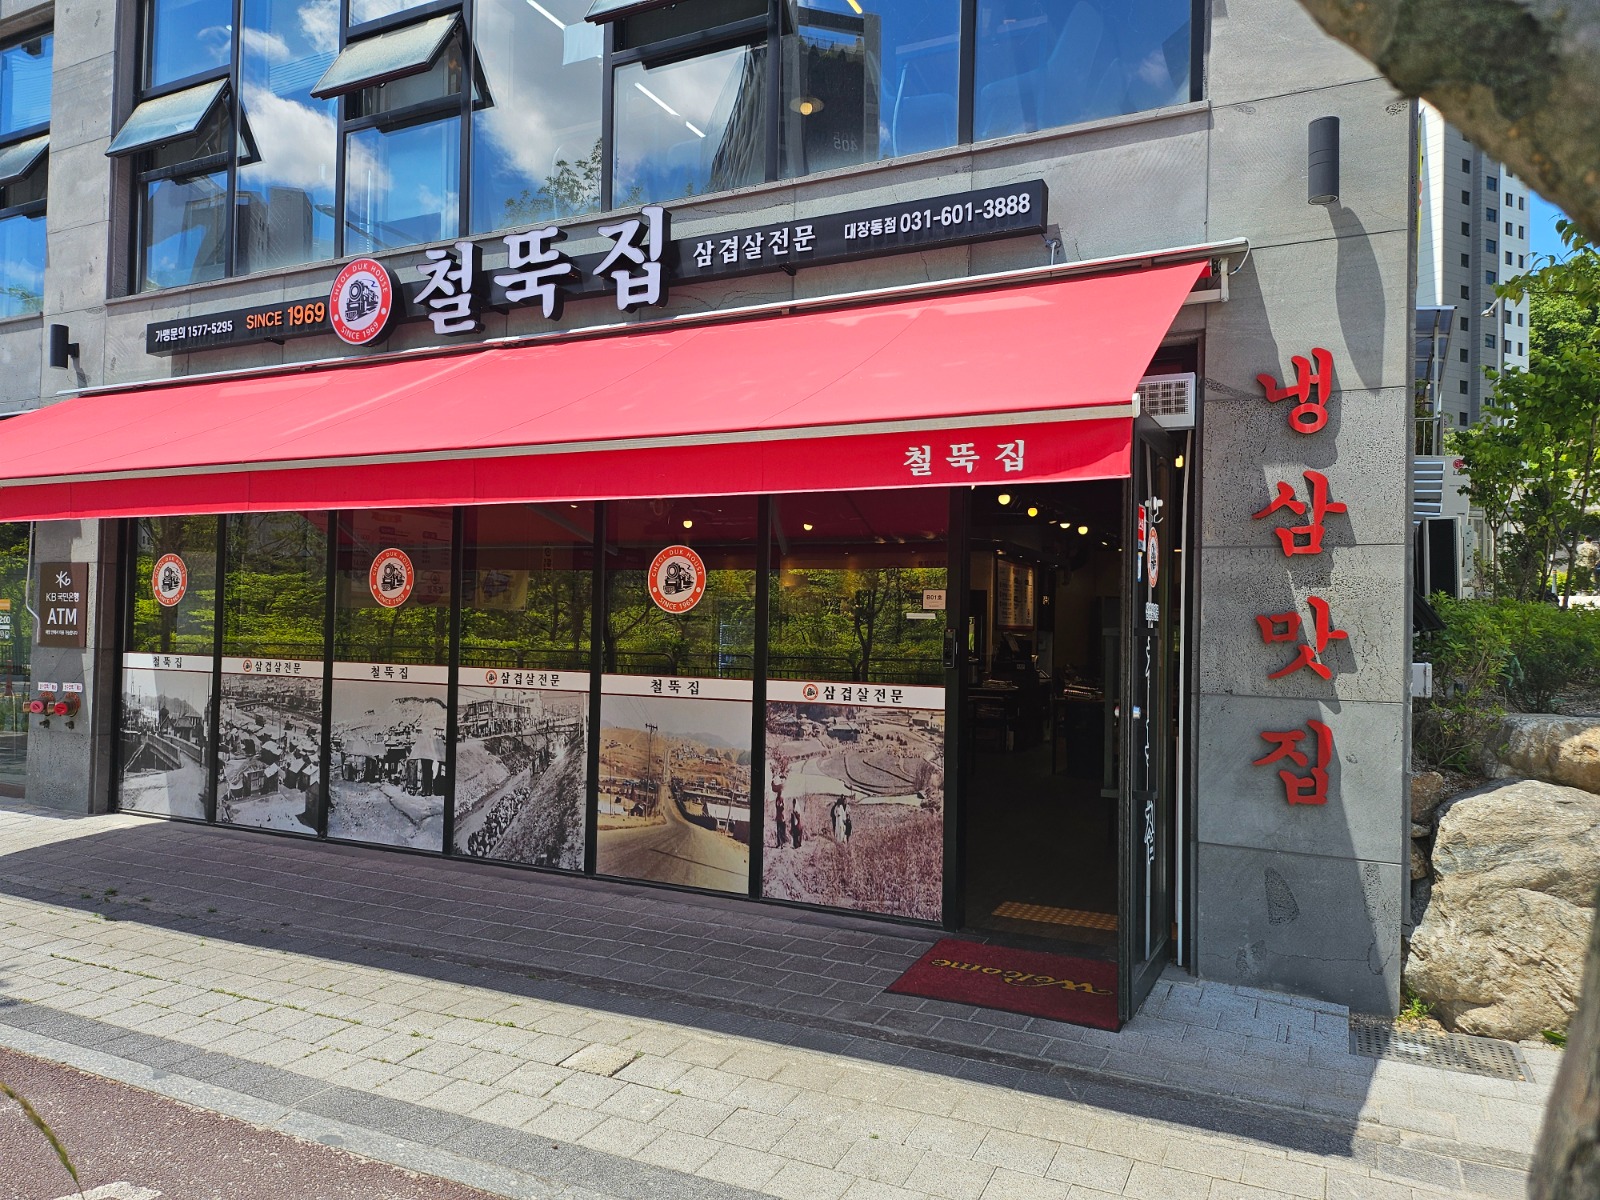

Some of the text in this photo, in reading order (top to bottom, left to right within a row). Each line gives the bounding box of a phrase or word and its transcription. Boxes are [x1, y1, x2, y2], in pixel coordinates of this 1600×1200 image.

[844, 192, 1032, 240] 대장동점 031-601-3888
[692, 224, 816, 268] 삼겹살전문
[413, 205, 665, 335] 철뚝집
[333, 262, 389, 302] CHEOL DUK HOUSE
[246, 302, 326, 330] SINCE 1969
[155, 320, 233, 343] 가맹문의 1577-5295
[341, 321, 379, 339] SINCE 1969
[903, 439, 1025, 476] 철뚝집
[652, 554, 667, 577] CHEOL
[1251, 346, 1349, 806] 냉삼맛집
[46, 592, 80, 603] KB 국민은행
[658, 597, 694, 610] SINCE 1969
[47, 608, 77, 625] ATM
[152, 656, 183, 669] 철뚝집
[255, 660, 302, 675] 삼겹살전문
[370, 665, 409, 679] 철뚝집
[500, 671, 560, 687] 삼겹살전문
[650, 679, 701, 695] 철뚝집
[823, 685, 904, 704] 삼겹살전문
[931, 959, 1114, 995] Welcome
